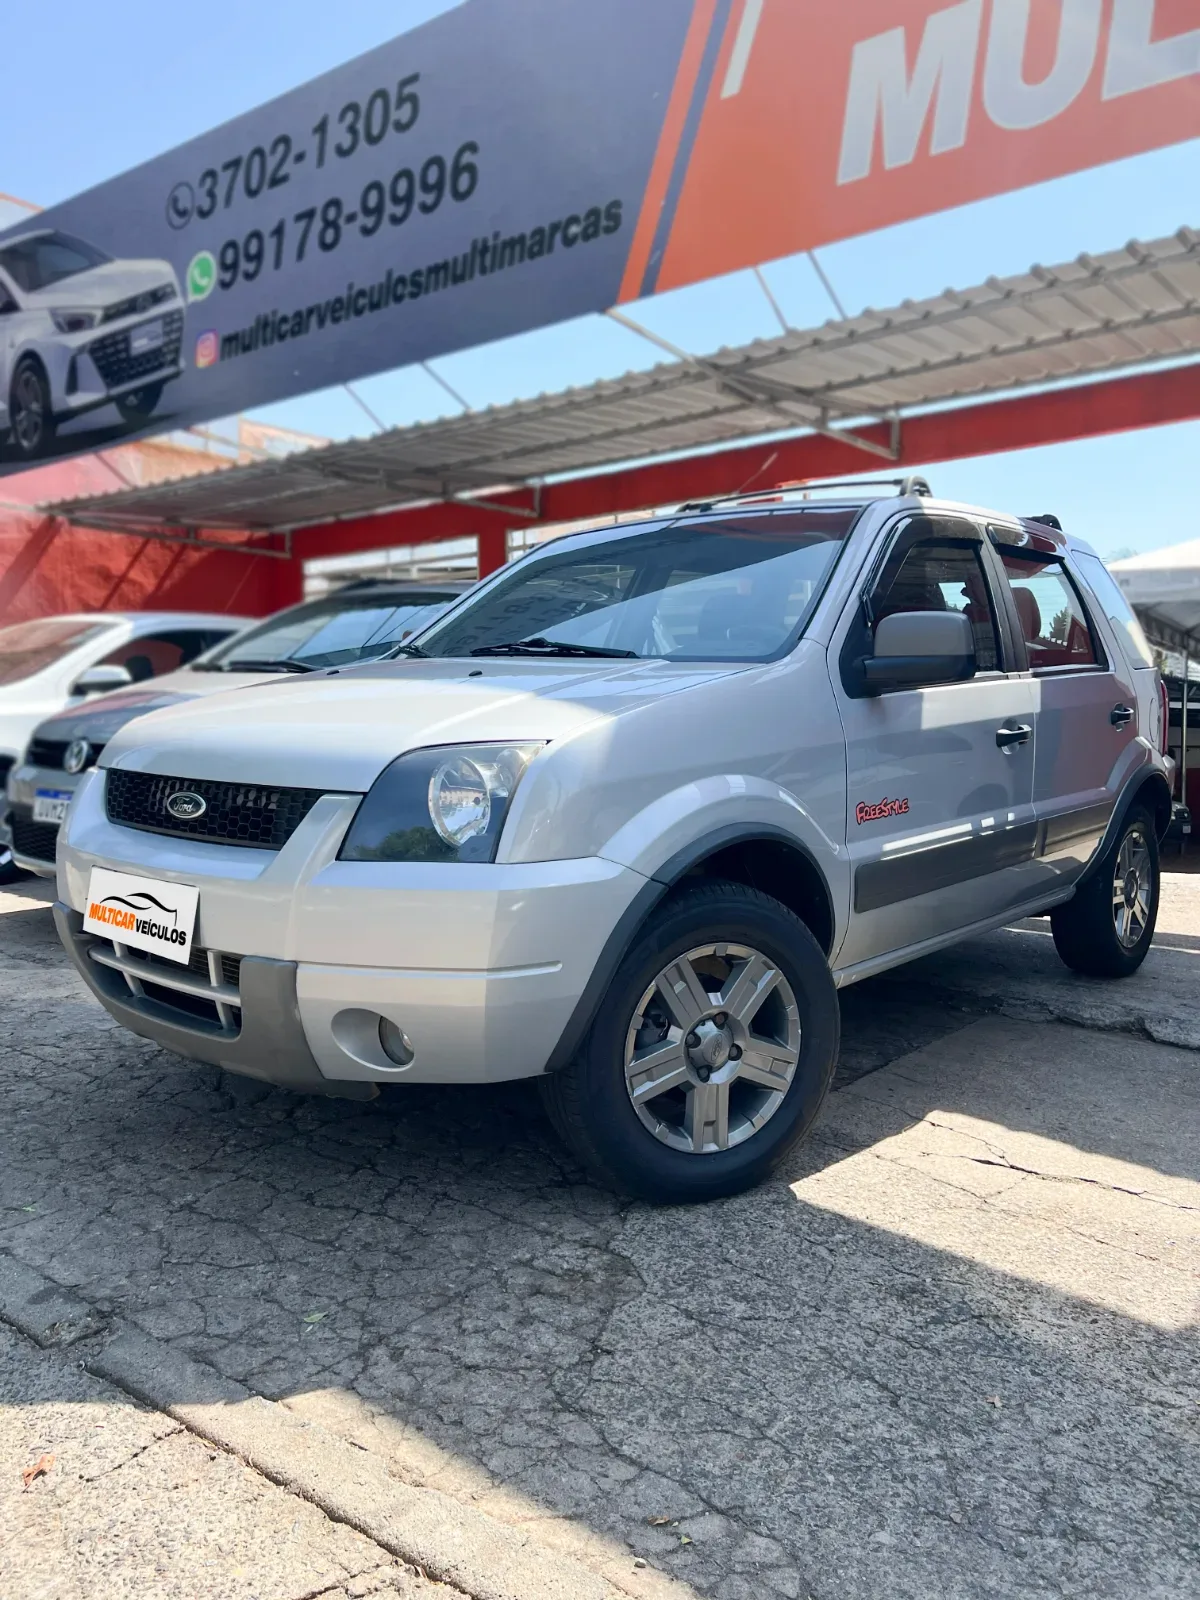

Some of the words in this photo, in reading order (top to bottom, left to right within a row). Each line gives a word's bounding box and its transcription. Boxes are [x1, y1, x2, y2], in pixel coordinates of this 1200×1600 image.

[196, 72, 420, 220] 3702-1305
[218, 141, 480, 290] 99178-9996
[219, 199, 623, 362] multicarveiculosmultimarcas
[173, 796, 195, 812] Ford
